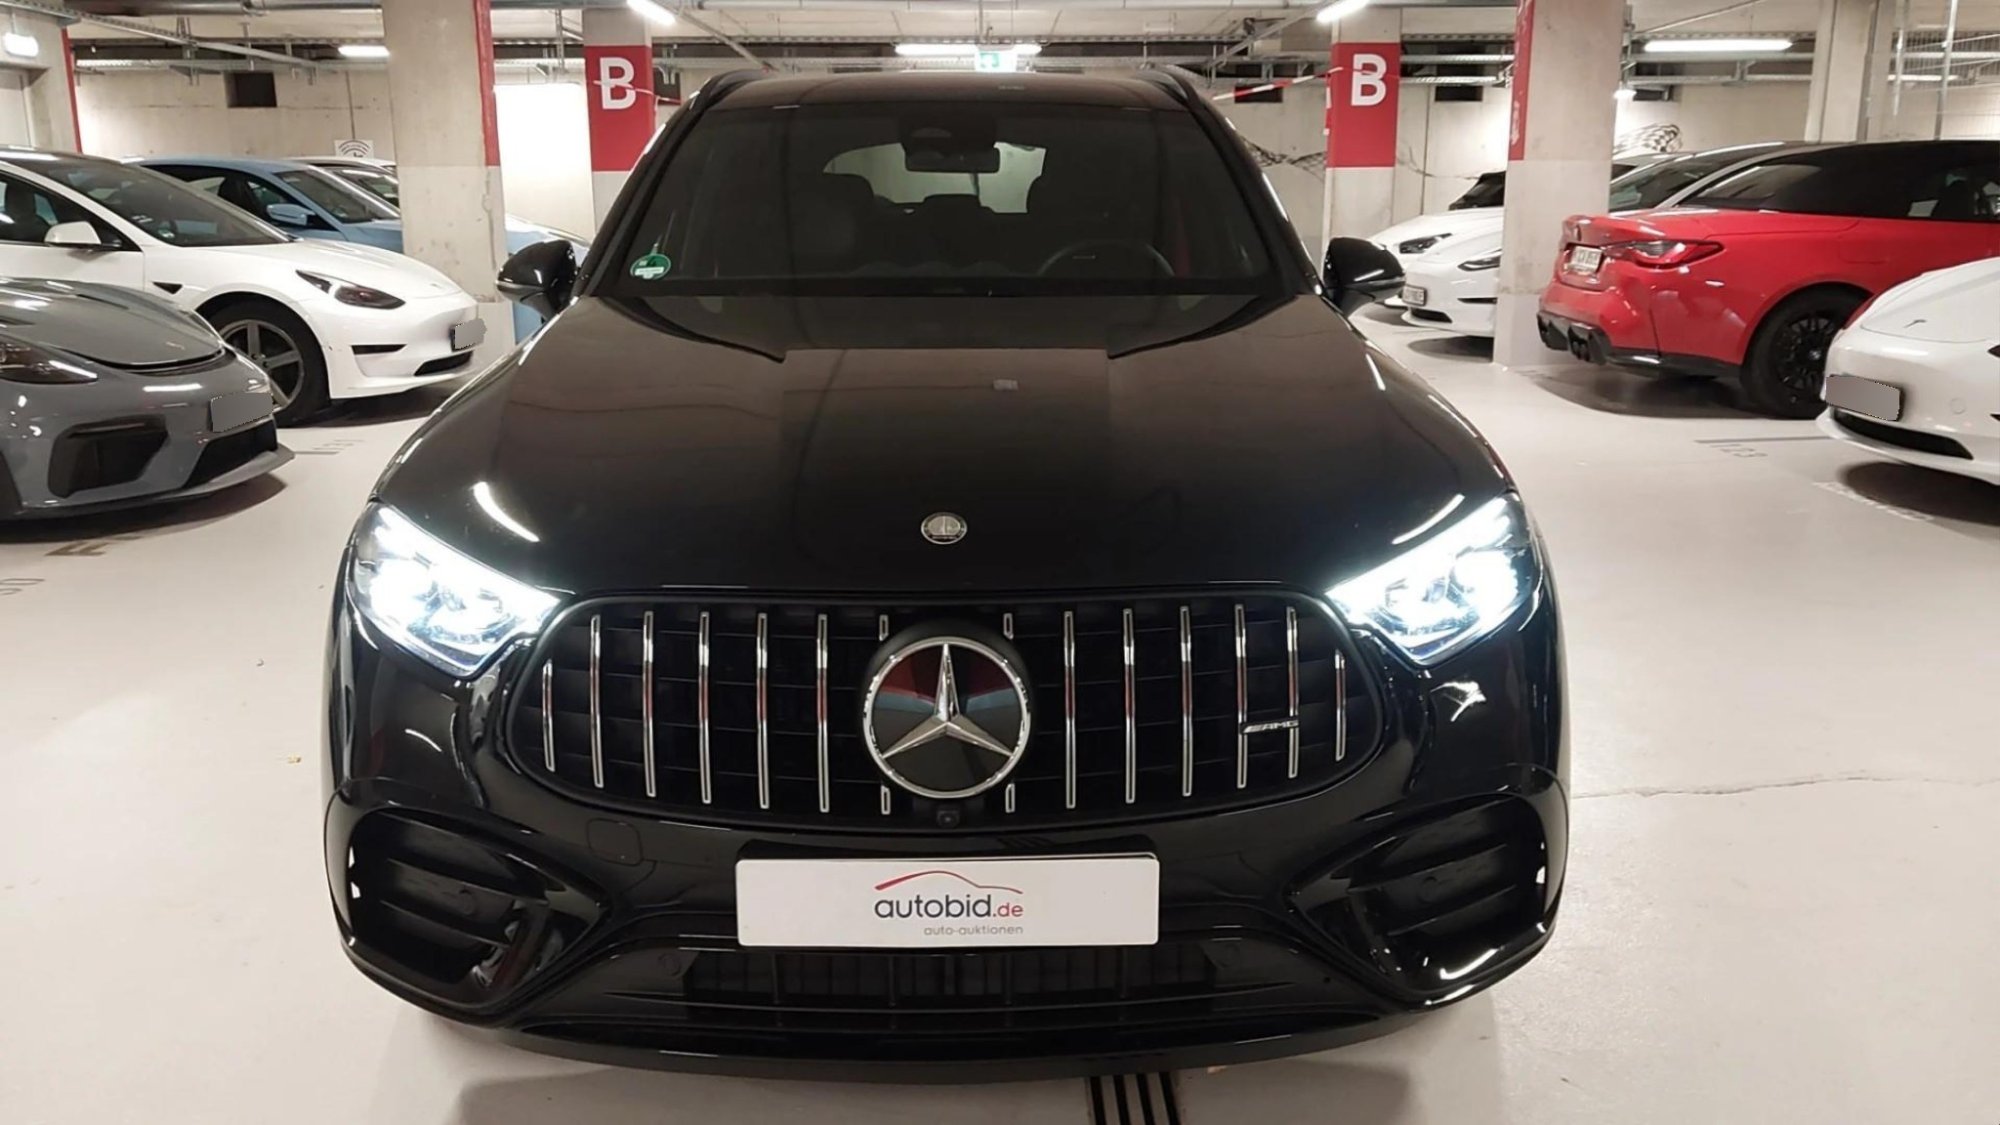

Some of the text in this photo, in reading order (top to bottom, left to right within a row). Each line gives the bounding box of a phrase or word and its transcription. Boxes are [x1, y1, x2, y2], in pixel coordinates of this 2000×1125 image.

[599, 56, 636, 110] B
[1351, 53, 1387, 107] B
[1261, 719, 1300, 731] AMG
[874, 893, 1024, 919] autobid.de
[923, 925, 1024, 936] auto-auktionen
